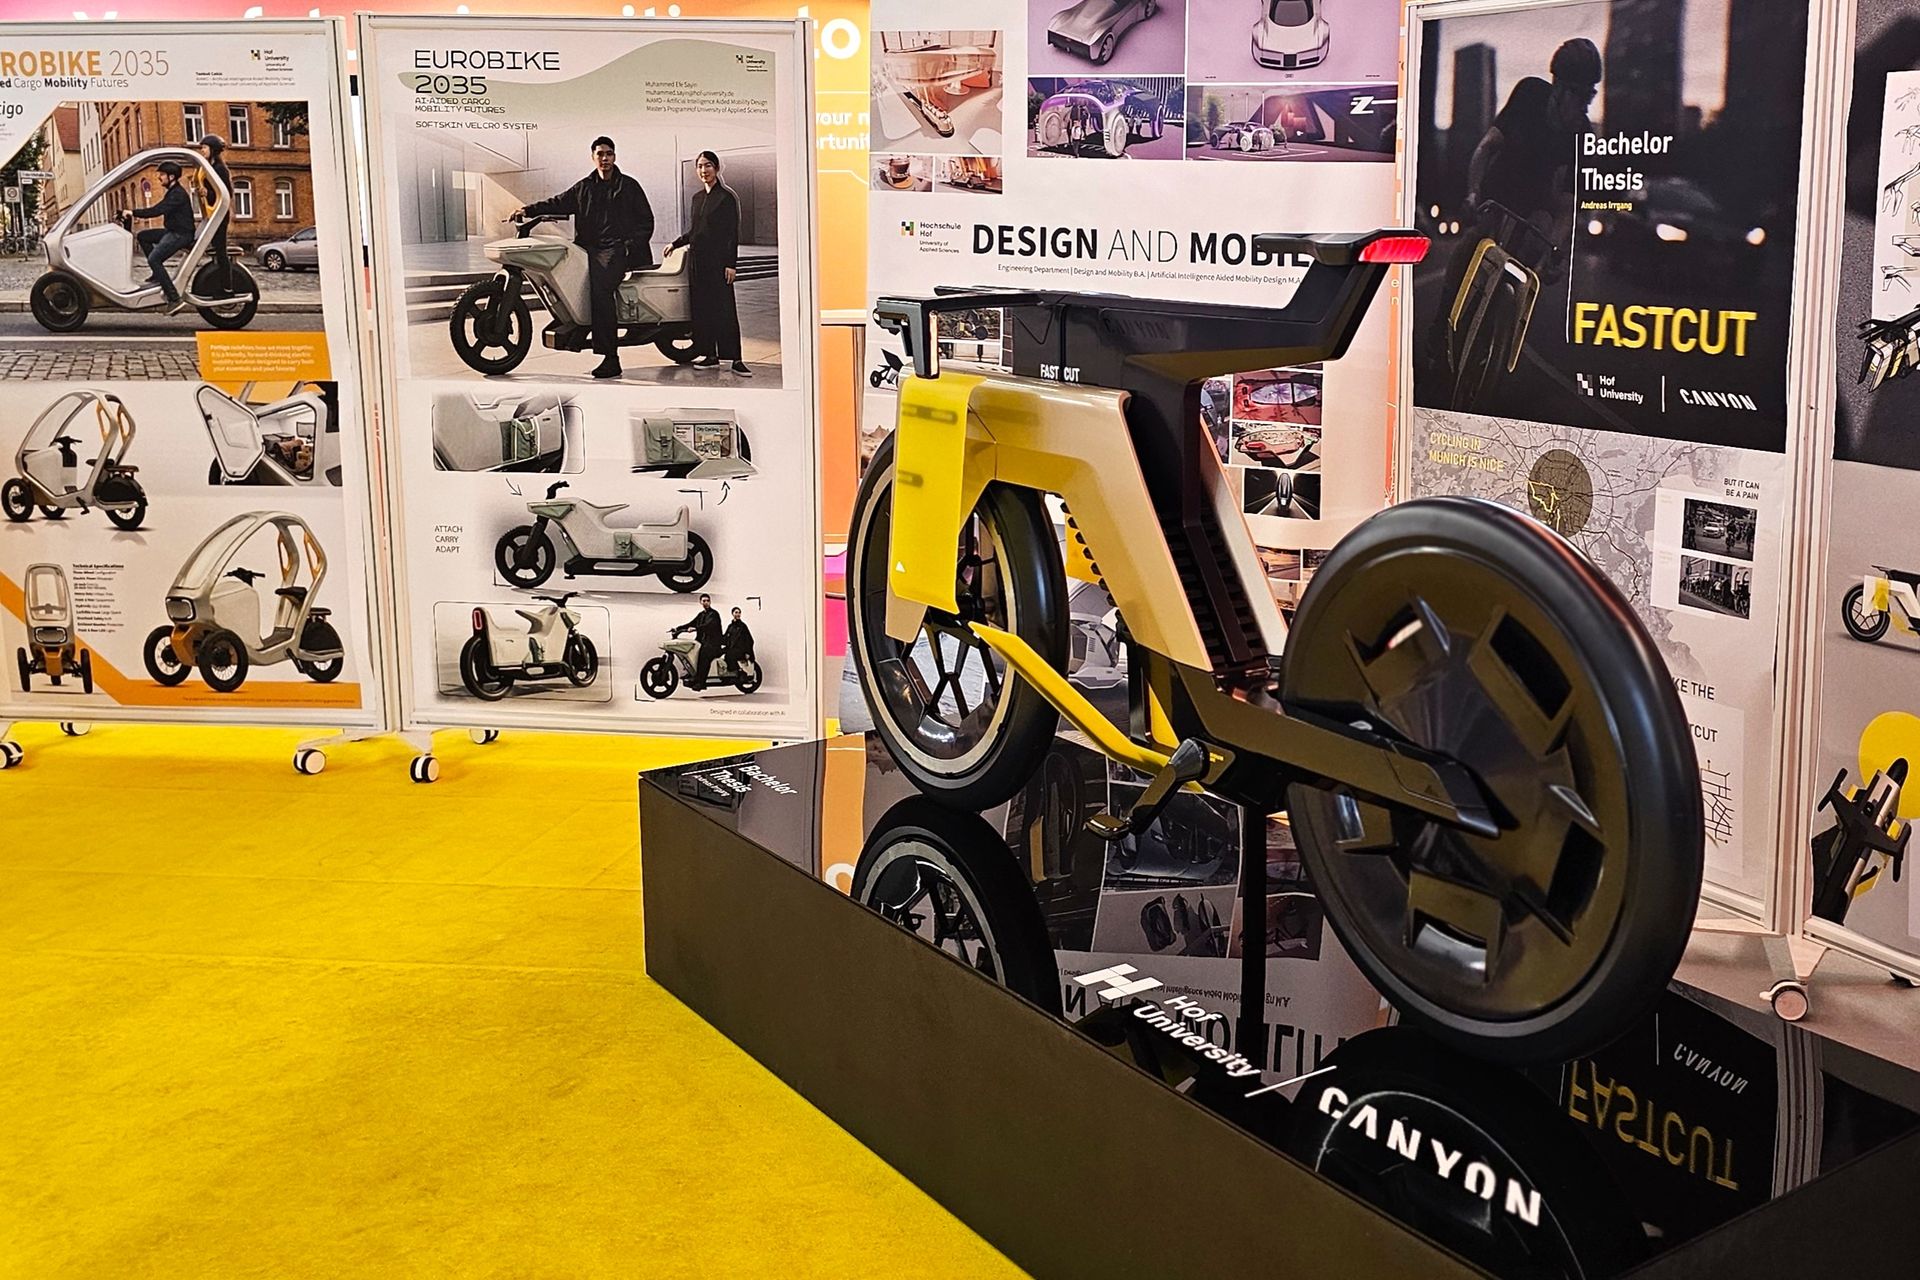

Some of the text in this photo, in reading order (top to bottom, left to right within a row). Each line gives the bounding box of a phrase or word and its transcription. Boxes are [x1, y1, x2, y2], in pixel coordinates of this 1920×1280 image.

[109, 50, 169, 76] 2035
[415, 50, 560, 70] EUROBIKE
[14, 78, 42, 91] Cargo
[45, 77, 88, 90] Mobility
[91, 77, 128, 88] Futures
[415, 75, 487, 94] 2035
[415, 97, 458, 105] AI-AIDED
[415, 105, 461, 113] MOBILITY
[416, 121, 463, 129] SOFTSKIN
[503, 122, 538, 130] SYSTEM
[1583, 130, 1674, 156] Bachelor
[1581, 166, 1643, 191] Thesis
[1580, 200, 1607, 210] Andreas
[920, 221, 962, 230] Hochschule
[920, 230, 933, 238] Hof
[972, 224, 1098, 260] DESIGN
[1107, 229, 1178, 263] AND
[998, 264, 1033, 274] Engineering
[1034, 265, 1070, 275] Department
[1074, 268, 1094, 277] Design
[1108, 269, 1133, 279] Mobility
[1150, 271, 1177, 279] Artificial
[1178, 272, 1215, 282] Intelligence
[1215, 273, 1234, 282] Aided
[1235, 274, 1262, 284] Mobility
[1263, 275, 1287, 285] Design
[1574, 302, 1757, 357] FASTCUT
[1040, 364, 1080, 382] FAST CUT
[1599, 375, 1616, 387] Hof
[1599, 388, 1644, 405] University
[1679, 388, 1758, 411] CANYON
[1430, 432, 1480, 450] CYCLING IN
[1428, 450, 1505, 472] MUNICH IS NICE
[1723, 478, 1760, 490] BUT IT CAN
[1725, 489, 1759, 500] BE A PAIN
[434, 525, 463, 533] ATTACH
[434, 535, 459, 543] CARRY
[435, 545, 460, 553] ADAPT
[1672, 677, 1715, 700] KE THE
[709, 769, 752, 793] Thesis
[738, 764, 798, 795] Bachelor
[1163, 994, 1222, 1023] Hof
[1133, 1004, 1262, 1078] University
[1318, 1086, 1542, 1227] CANYON
